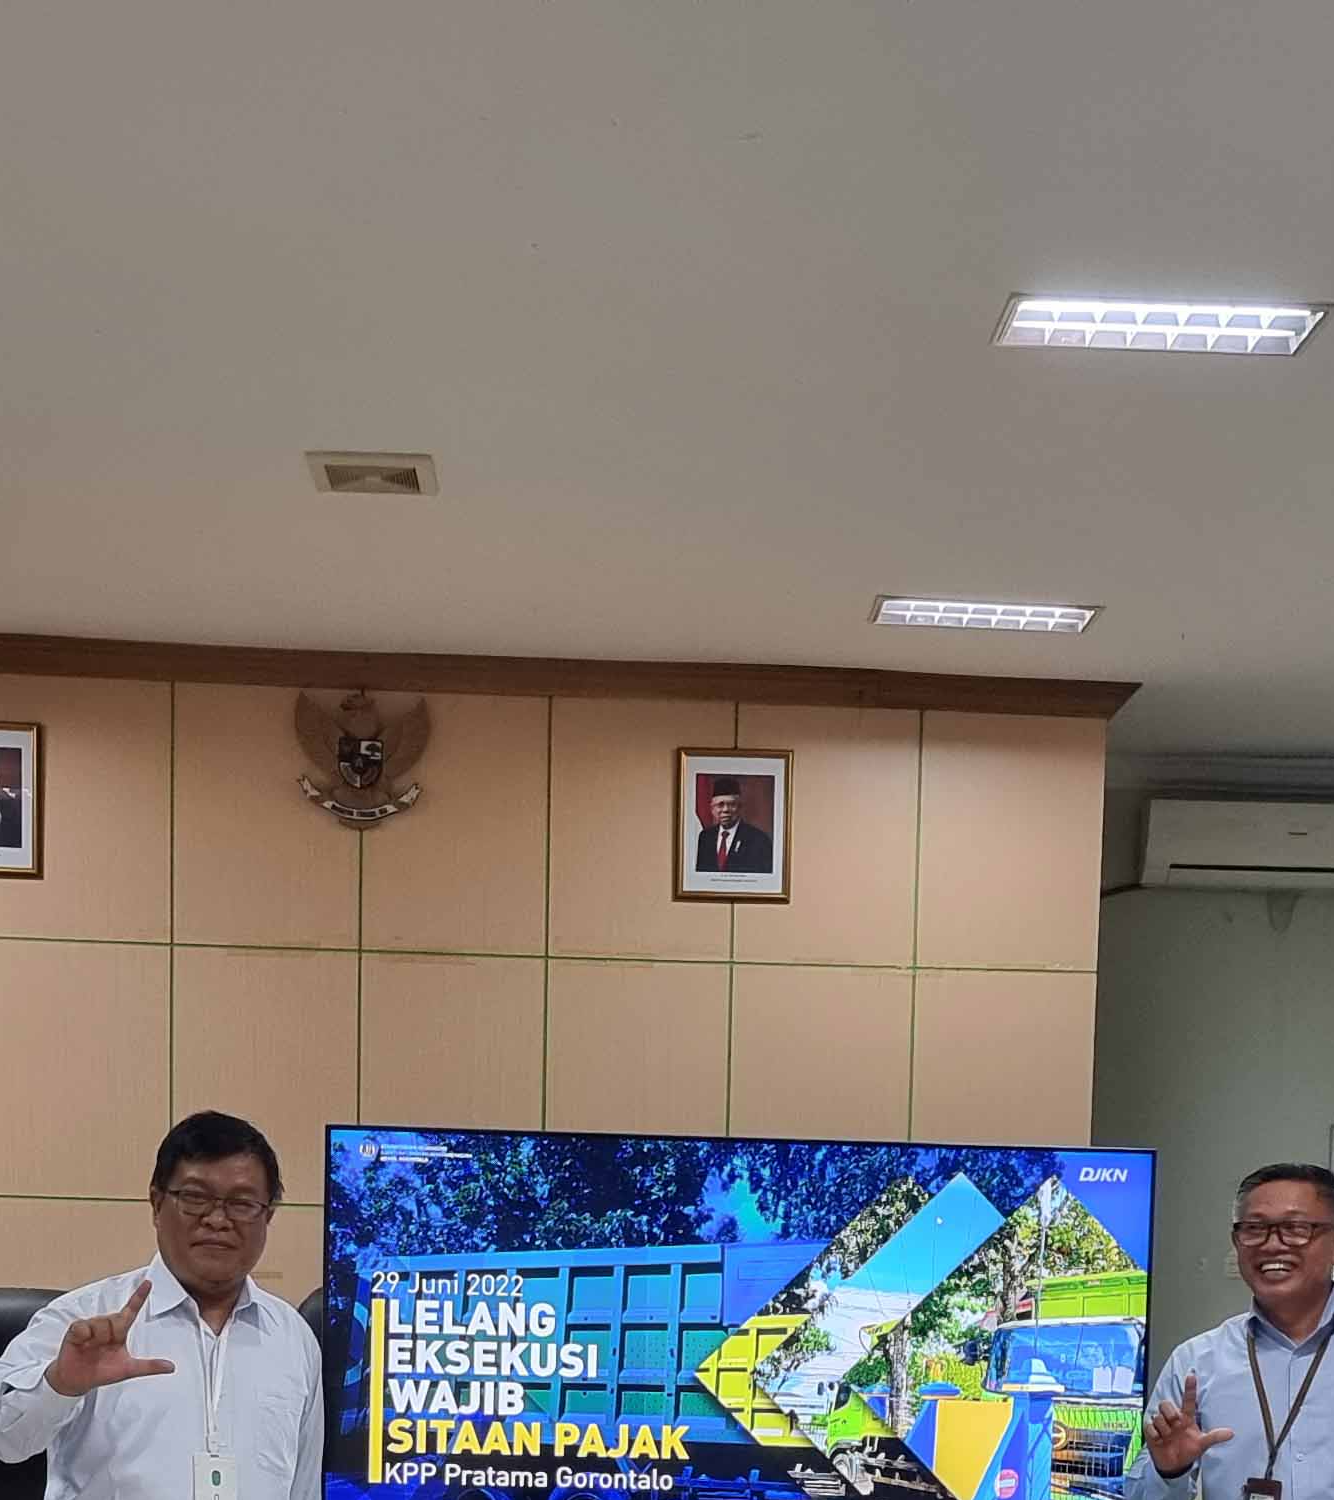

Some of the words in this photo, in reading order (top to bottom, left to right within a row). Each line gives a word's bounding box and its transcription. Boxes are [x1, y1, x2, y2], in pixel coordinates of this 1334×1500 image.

[1078, 1166, 1129, 1184] DJKN
[371, 1271, 400, 1294] 29
[407, 1273, 459, 1295] Juni
[466, 1274, 524, 1297] 2022
[388, 1299, 556, 1337] LELANG
[387, 1338, 598, 1379] EKSEKUSI
[387, 1379, 525, 1416] WAJIB
[386, 1419, 541, 1457] SITAAN
[554, 1422, 690, 1461] PAJAK
[385, 1462, 437, 1485] KPP
[444, 1464, 548, 1488] Pratama
[555, 1467, 674, 1491] Gorontalo
